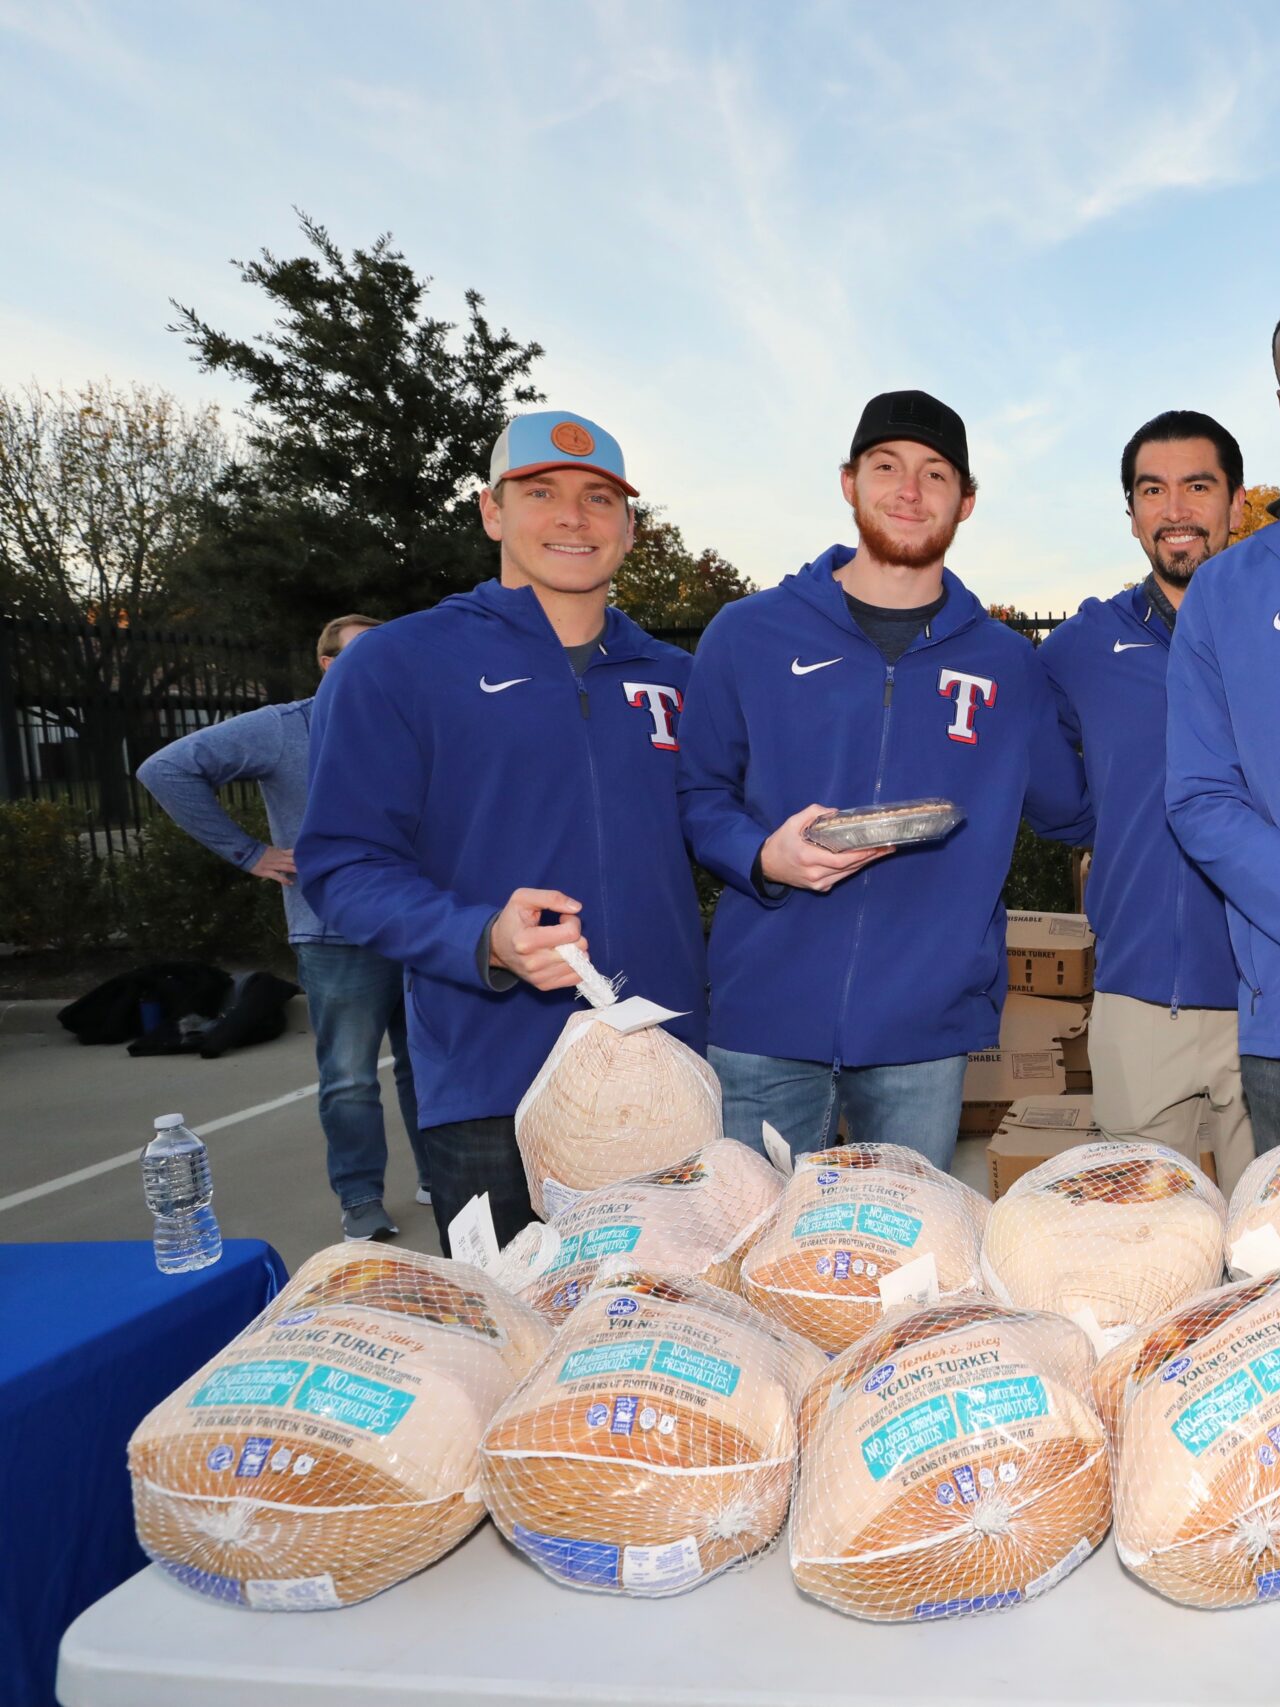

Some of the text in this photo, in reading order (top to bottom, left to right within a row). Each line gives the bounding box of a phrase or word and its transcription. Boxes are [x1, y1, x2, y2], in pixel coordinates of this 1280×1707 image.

[621, 680, 684, 752] T
[938, 666, 999, 746] T
[1028, 951, 1056, 959] TURKEY
[862, 1184, 908, 1200] TURKEY
[608, 1318, 722, 1345] YOUNG TURKEY
[266, 1328, 331, 1344] YOUNG
[331, 1331, 405, 1365] TURKEY
[671, 1344, 690, 1358] NO
[899, 1348, 946, 1371] Tender
[1177, 1351, 1229, 1388] YOUNG
[1262, 1352, 1280, 1370] NO
[321, 1369, 349, 1391] NO
[661, 1356, 730, 1389] PRESERVATIVES
[877, 1350, 1000, 1401] YOUNG TURKEY
[578, 1381, 609, 1392] GRAMS
[610, 1379, 621, 1389] OF
[659, 1383, 675, 1397] PER
[675, 1387, 707, 1408] SERVING
[256, 1417, 300, 1435] PROTEIN
[865, 1438, 884, 1462] NO
